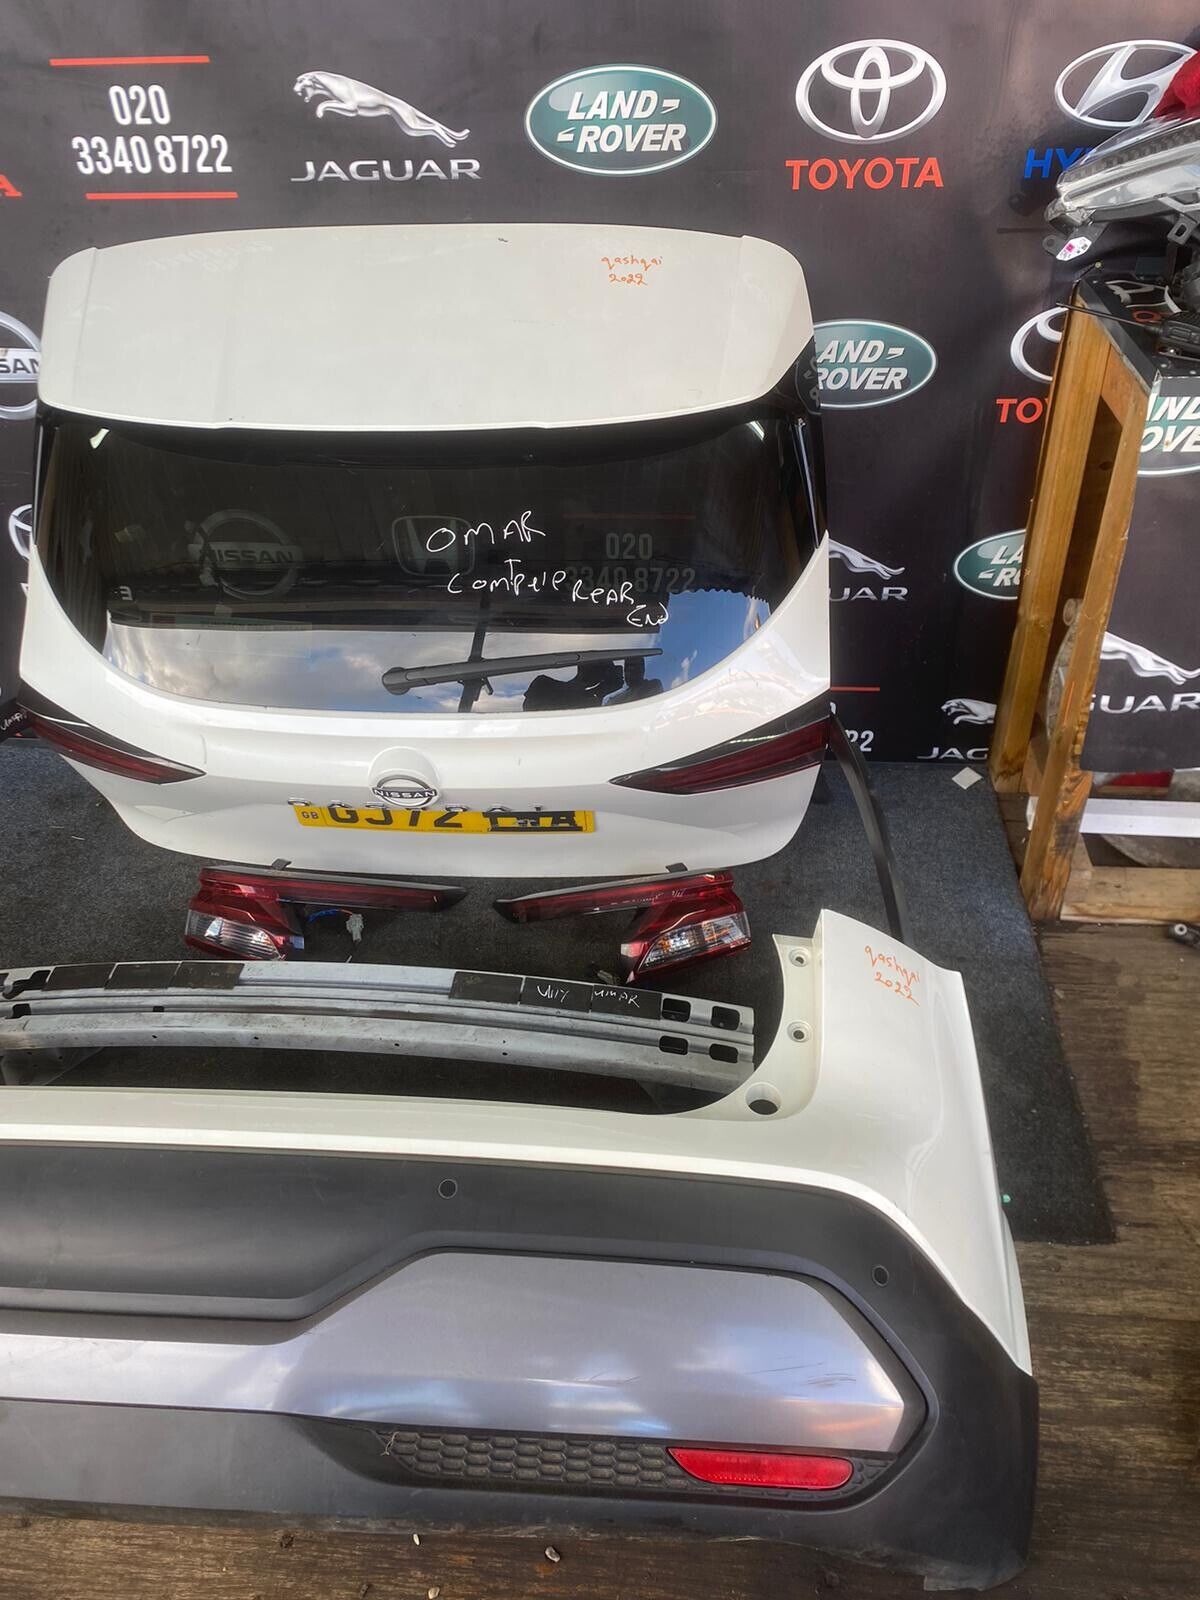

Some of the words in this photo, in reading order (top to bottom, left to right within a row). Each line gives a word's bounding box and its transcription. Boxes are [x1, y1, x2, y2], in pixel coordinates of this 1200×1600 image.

[108, 84, 171, 125] 020
[567, 89, 659, 121] LAND
[576, 123, 687, 153] ROVER
[71, 135, 152, 175] 3340
[153, 134, 233, 174] 8722
[290, 158, 481, 183] JAGUAR
[785, 157, 944, 191] TOYOTA
[816, 340, 885, 363] AND
[426, 510, 546, 552] OMAR
[605, 532, 653, 560] 020
[373, 788, 437, 799] NISSAN
